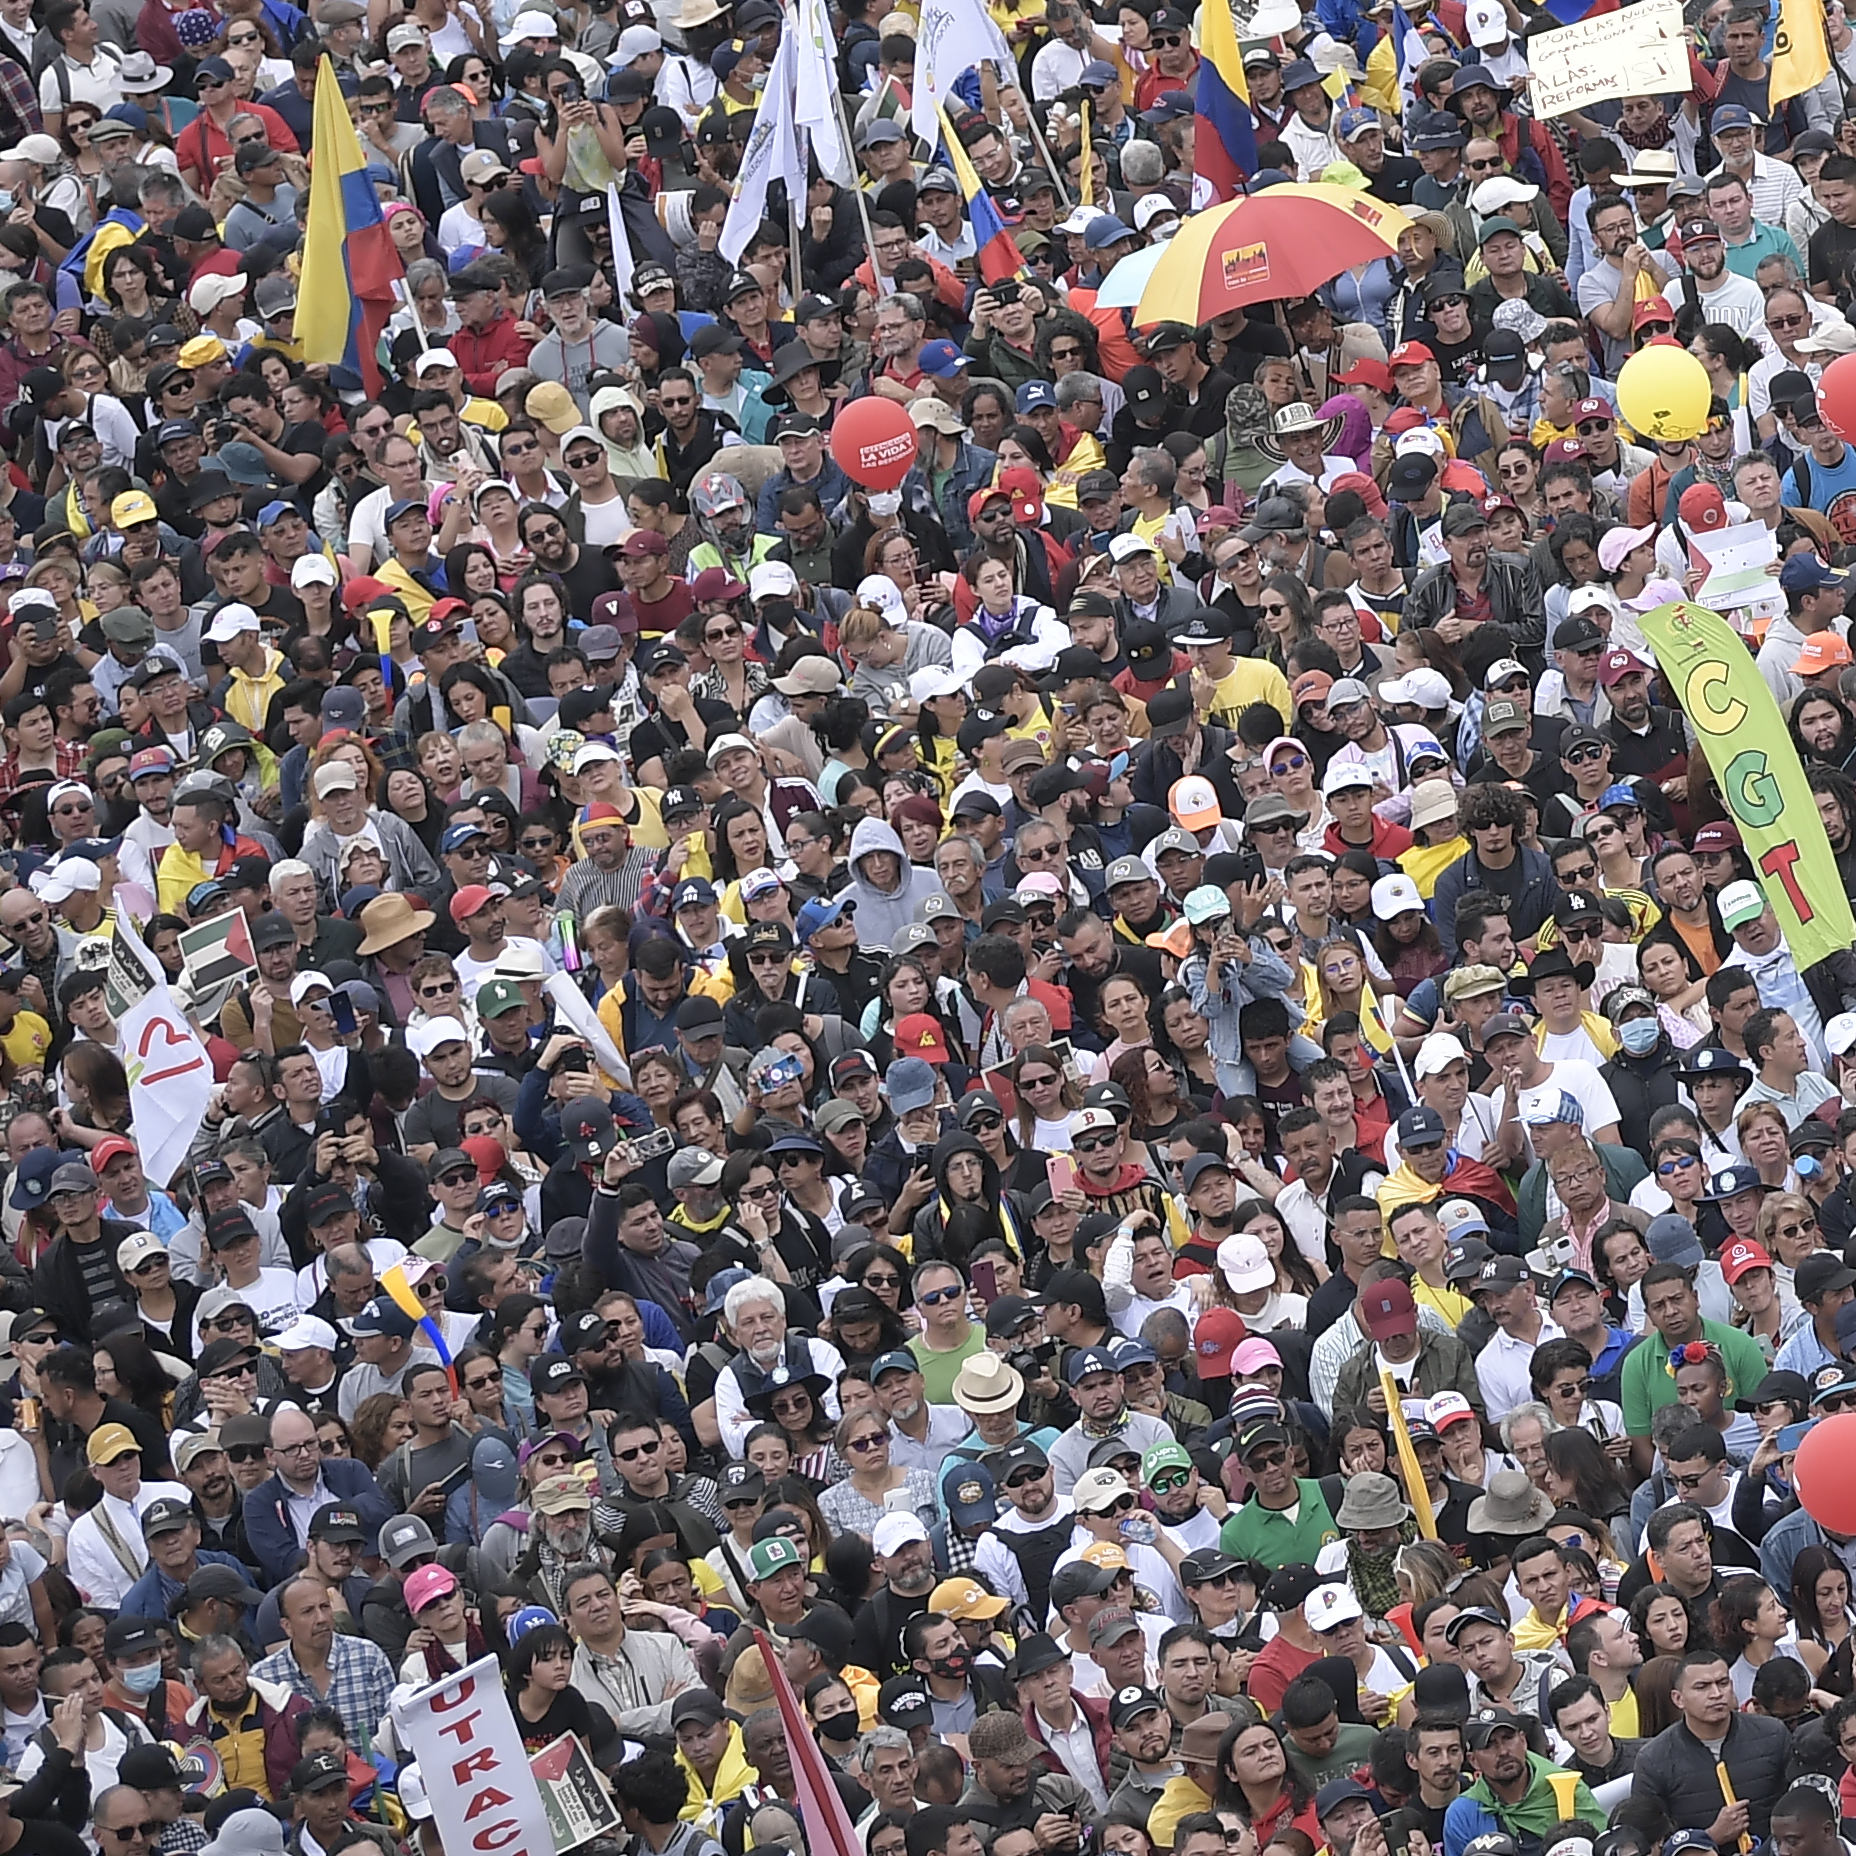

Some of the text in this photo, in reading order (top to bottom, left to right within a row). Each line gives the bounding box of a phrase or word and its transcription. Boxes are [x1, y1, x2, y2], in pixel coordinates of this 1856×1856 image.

[1535, 19, 1613, 49] POR LAS
[1541, 74, 1618, 110] REFORMAS
[861, 444, 907, 462] LA VIDA
[429, 1676, 527, 1856] UTRAC
